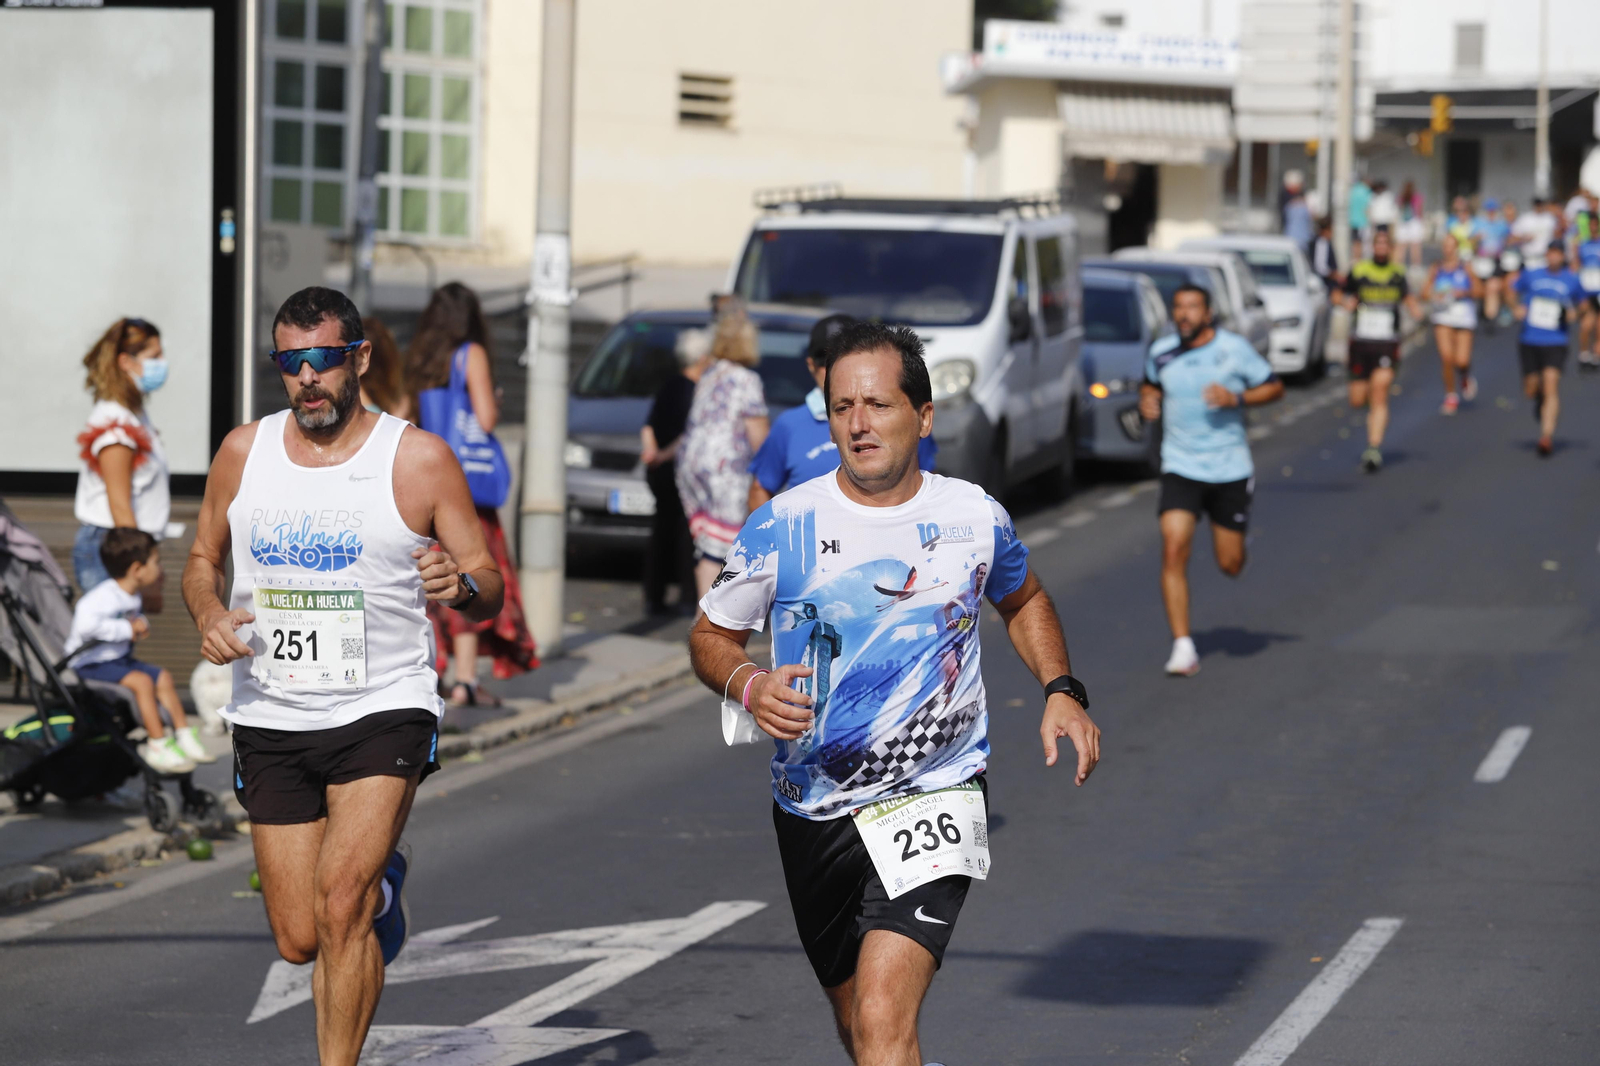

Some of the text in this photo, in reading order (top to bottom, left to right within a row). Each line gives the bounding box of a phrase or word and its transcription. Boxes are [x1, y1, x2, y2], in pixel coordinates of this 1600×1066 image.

[250, 508, 364, 528] RUNNERS
[251, 515, 361, 552] la Palmera
[939, 525, 975, 539] HUELVA
[260, 593, 355, 609] 34 VUELTA A HUELVA
[278, 611, 303, 620] CÉSAR
[272, 628, 318, 661] 251
[865, 804, 879, 821] 34
[875, 795, 946, 829] MIGUEL ANGEL
[893, 812, 962, 863] 236
